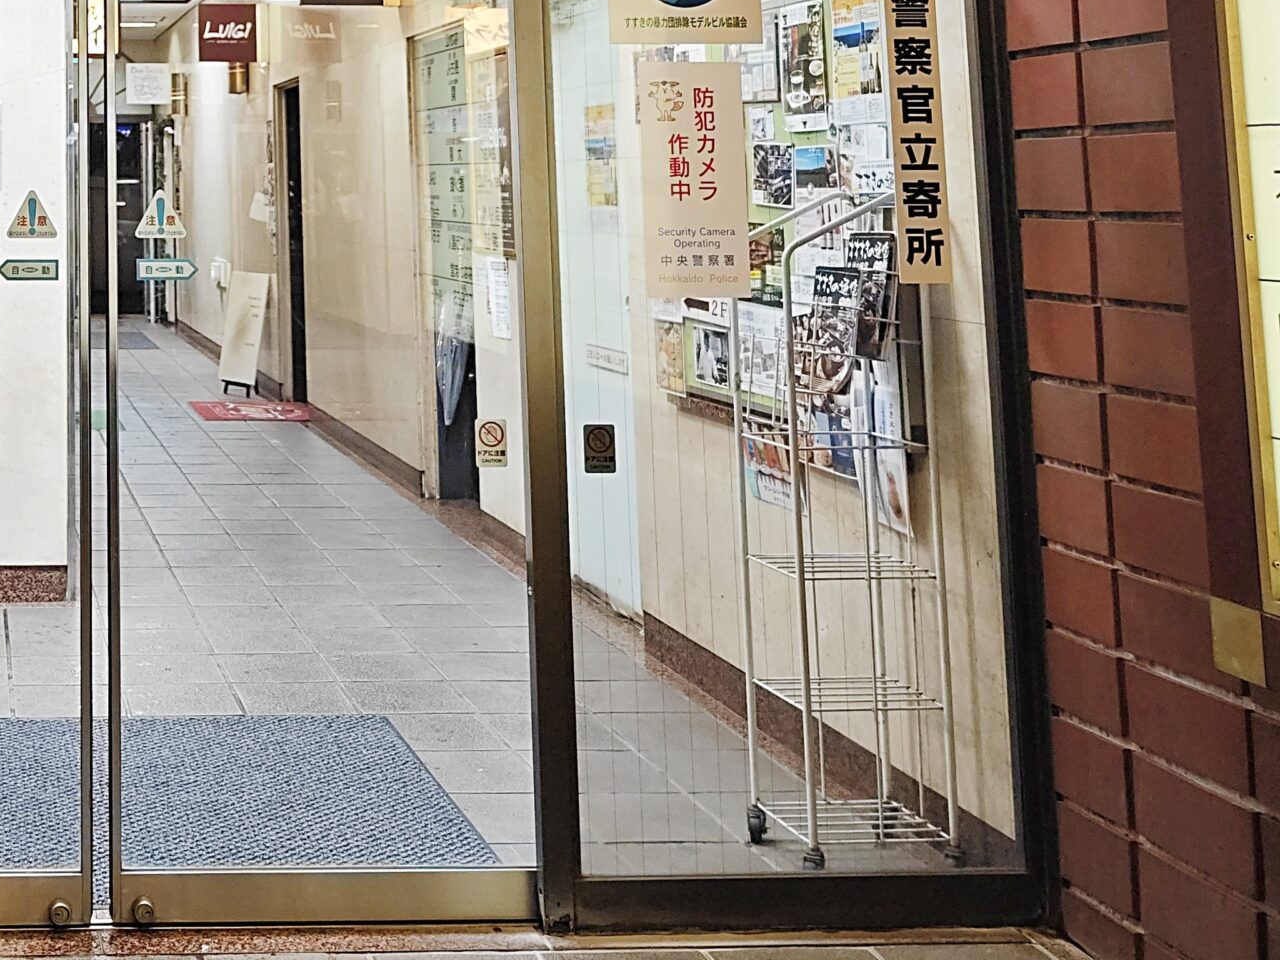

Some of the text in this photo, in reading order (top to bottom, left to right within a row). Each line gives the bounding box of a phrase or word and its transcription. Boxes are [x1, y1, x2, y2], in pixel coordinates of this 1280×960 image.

[623, 16, 748, 29] すすきの暴力団排除モデルビル協議会
[692, 87, 718, 201] 防犯カメラ
[667, 133, 691, 202] 作動中
[657, 227, 736, 238] Security Camera
[673, 238, 721, 250] Operating
[660, 254, 735, 267] 中央警察署
[658, 274, 739, 284] Hokkaido Police
[711, 299, 728, 318] 2F
